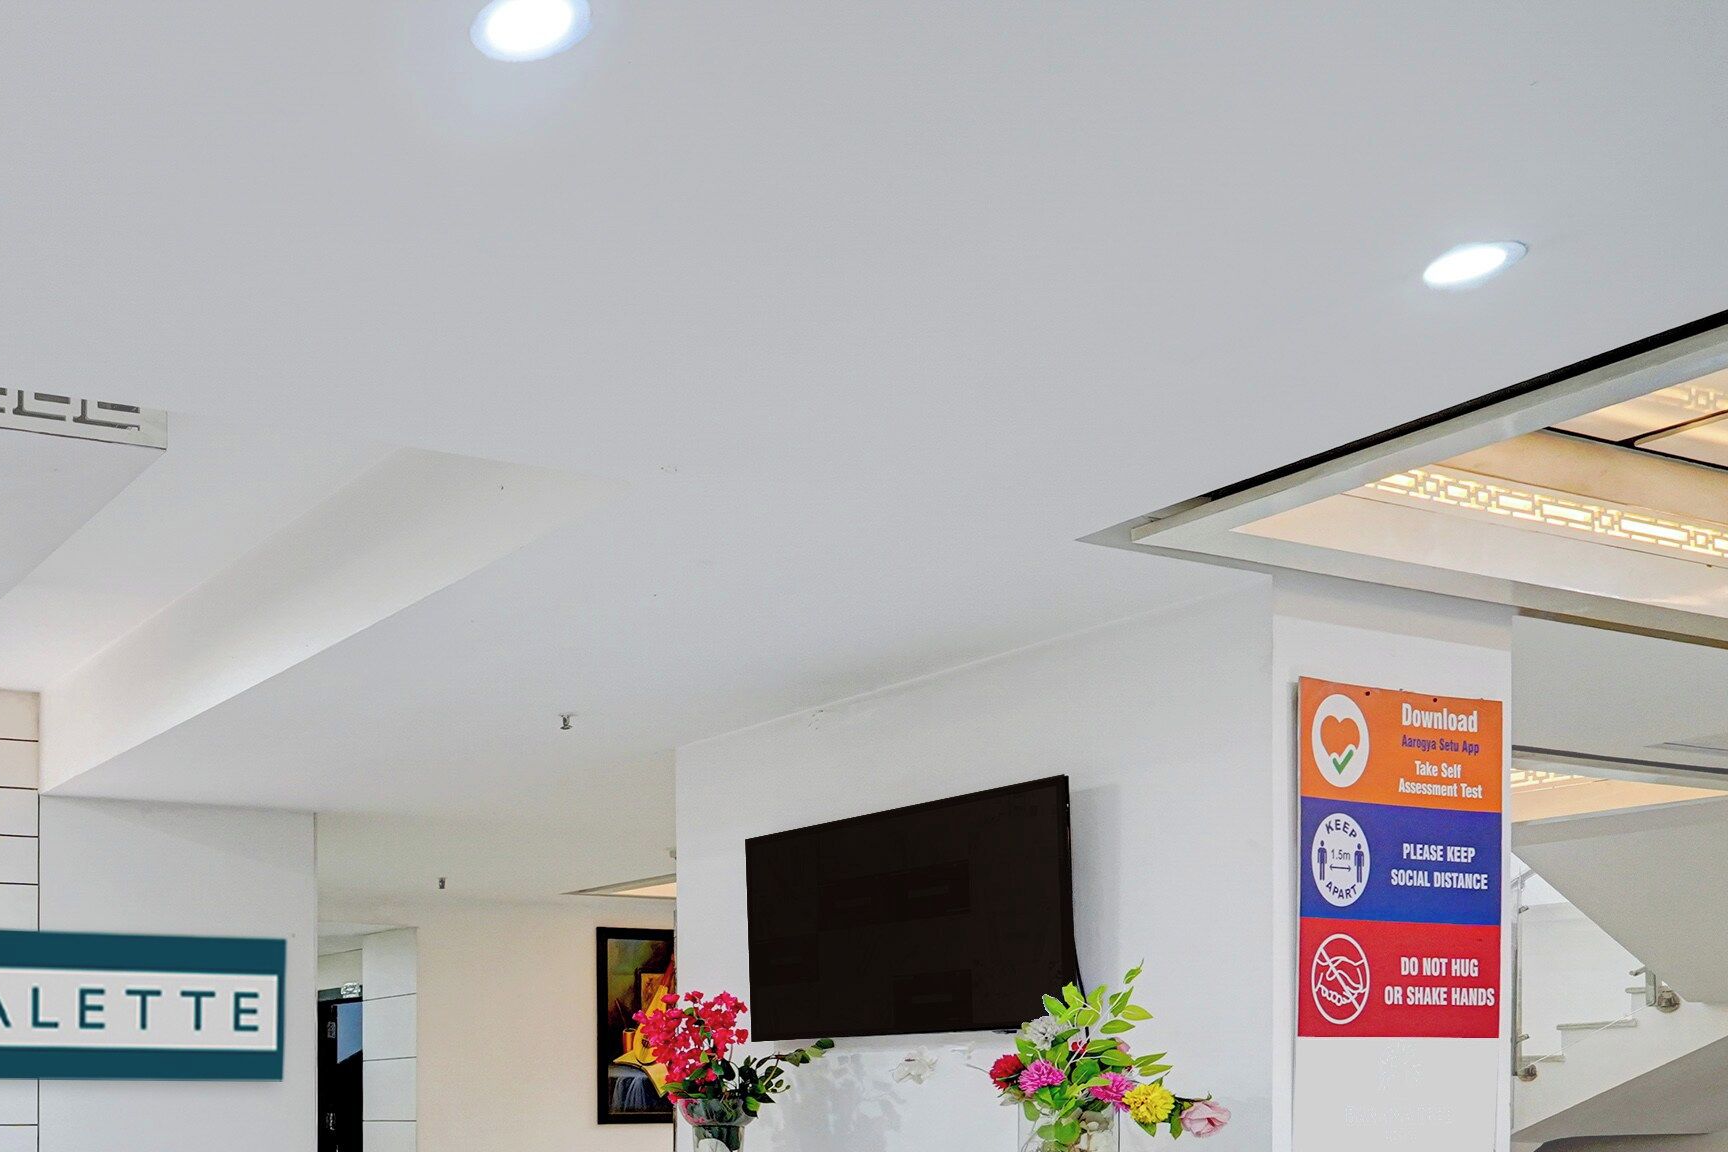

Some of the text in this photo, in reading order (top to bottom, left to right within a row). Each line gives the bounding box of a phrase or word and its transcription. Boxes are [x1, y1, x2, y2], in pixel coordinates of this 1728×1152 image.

[1401, 703, 1478, 732] Download
[1401, 734, 1480, 755] Aarogya Setu App
[1414, 760, 1462, 778] Take Self
[1398, 778, 1483, 799] Assessment Test
[1325, 819, 1358, 839] KEEP
[1331, 849, 1351, 861] 1.5m
[1402, 843, 1476, 863] PLEASE KEEP
[1390, 869, 1489, 890] SOCIAL DISTANCE
[1325, 881, 1358, 900] APART
[1400, 956, 1479, 977] DO NOT HUG
[1384, 985, 1495, 1006] OR SHAKE HANDS
